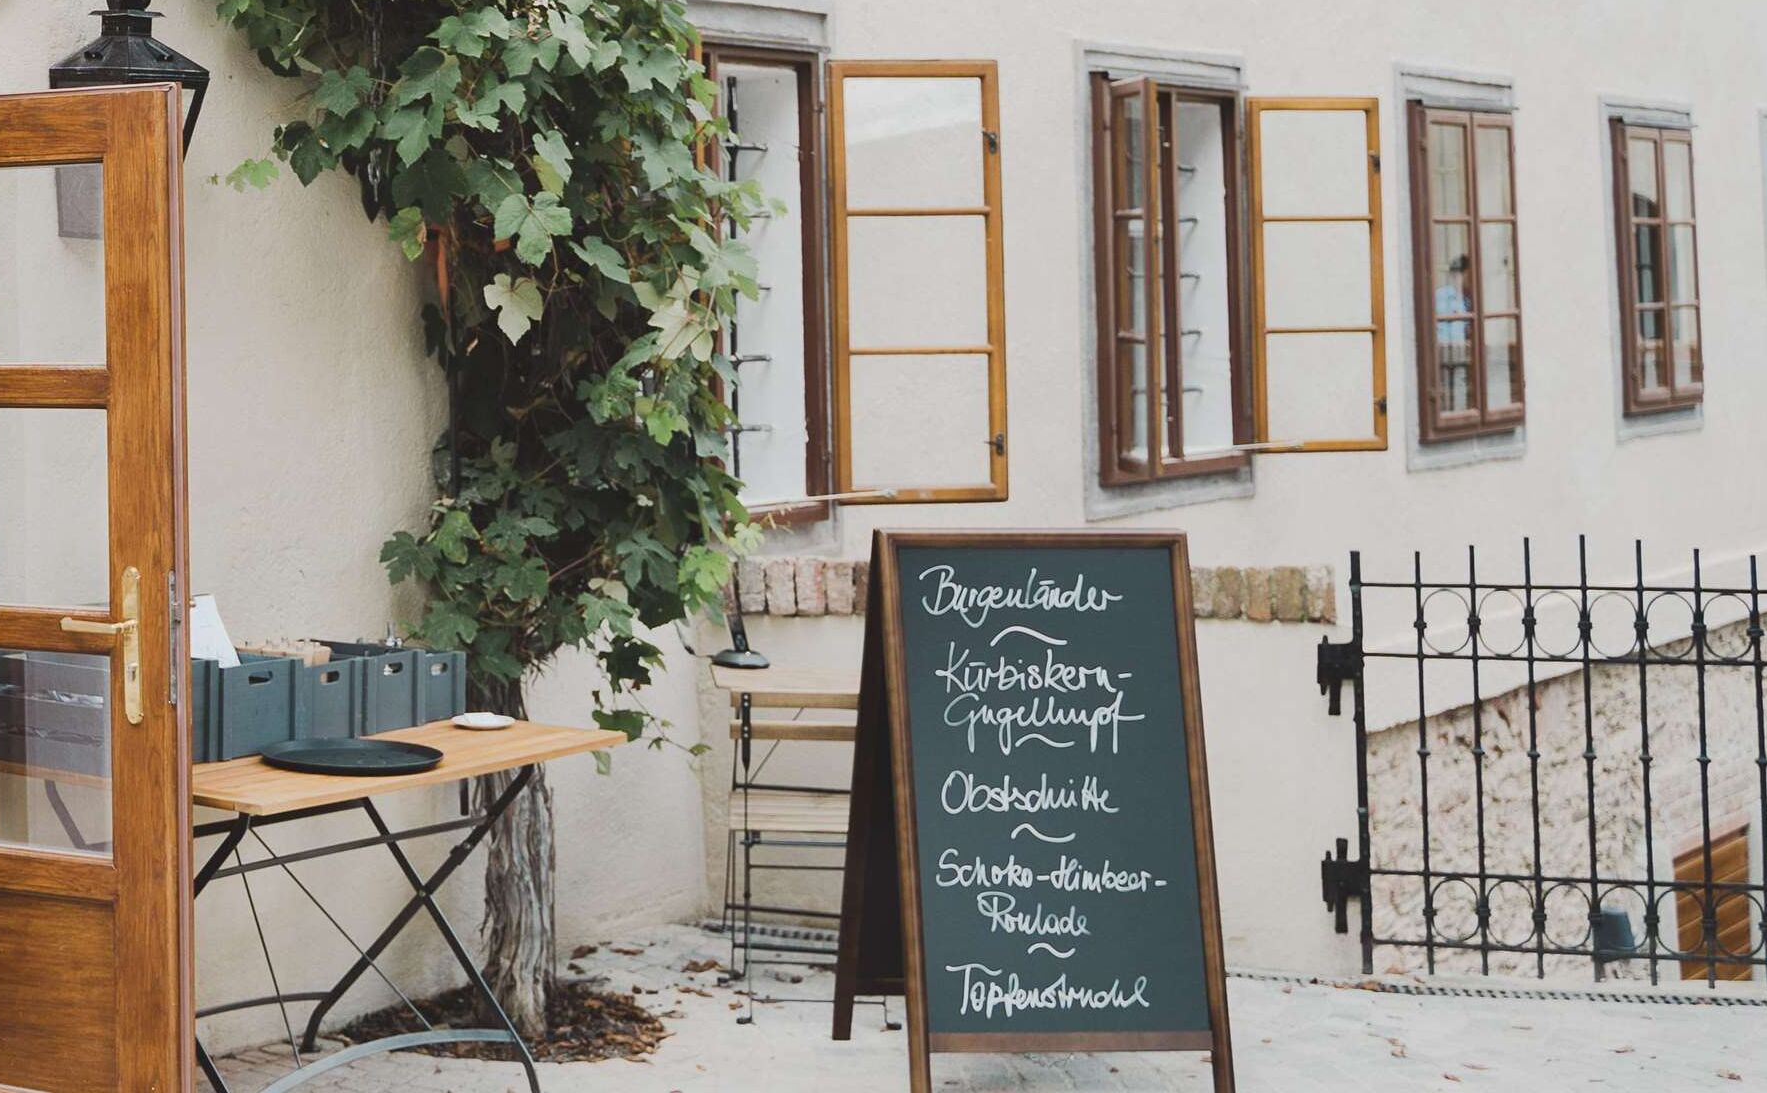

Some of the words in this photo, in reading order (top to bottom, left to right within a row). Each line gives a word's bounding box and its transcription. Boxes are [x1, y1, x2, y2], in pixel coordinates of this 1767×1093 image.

[918, 564, 1123, 628] Burgenländer
[941, 770, 1120, 815] Obstschnitte
[977, 891, 1091, 936] Roulade
